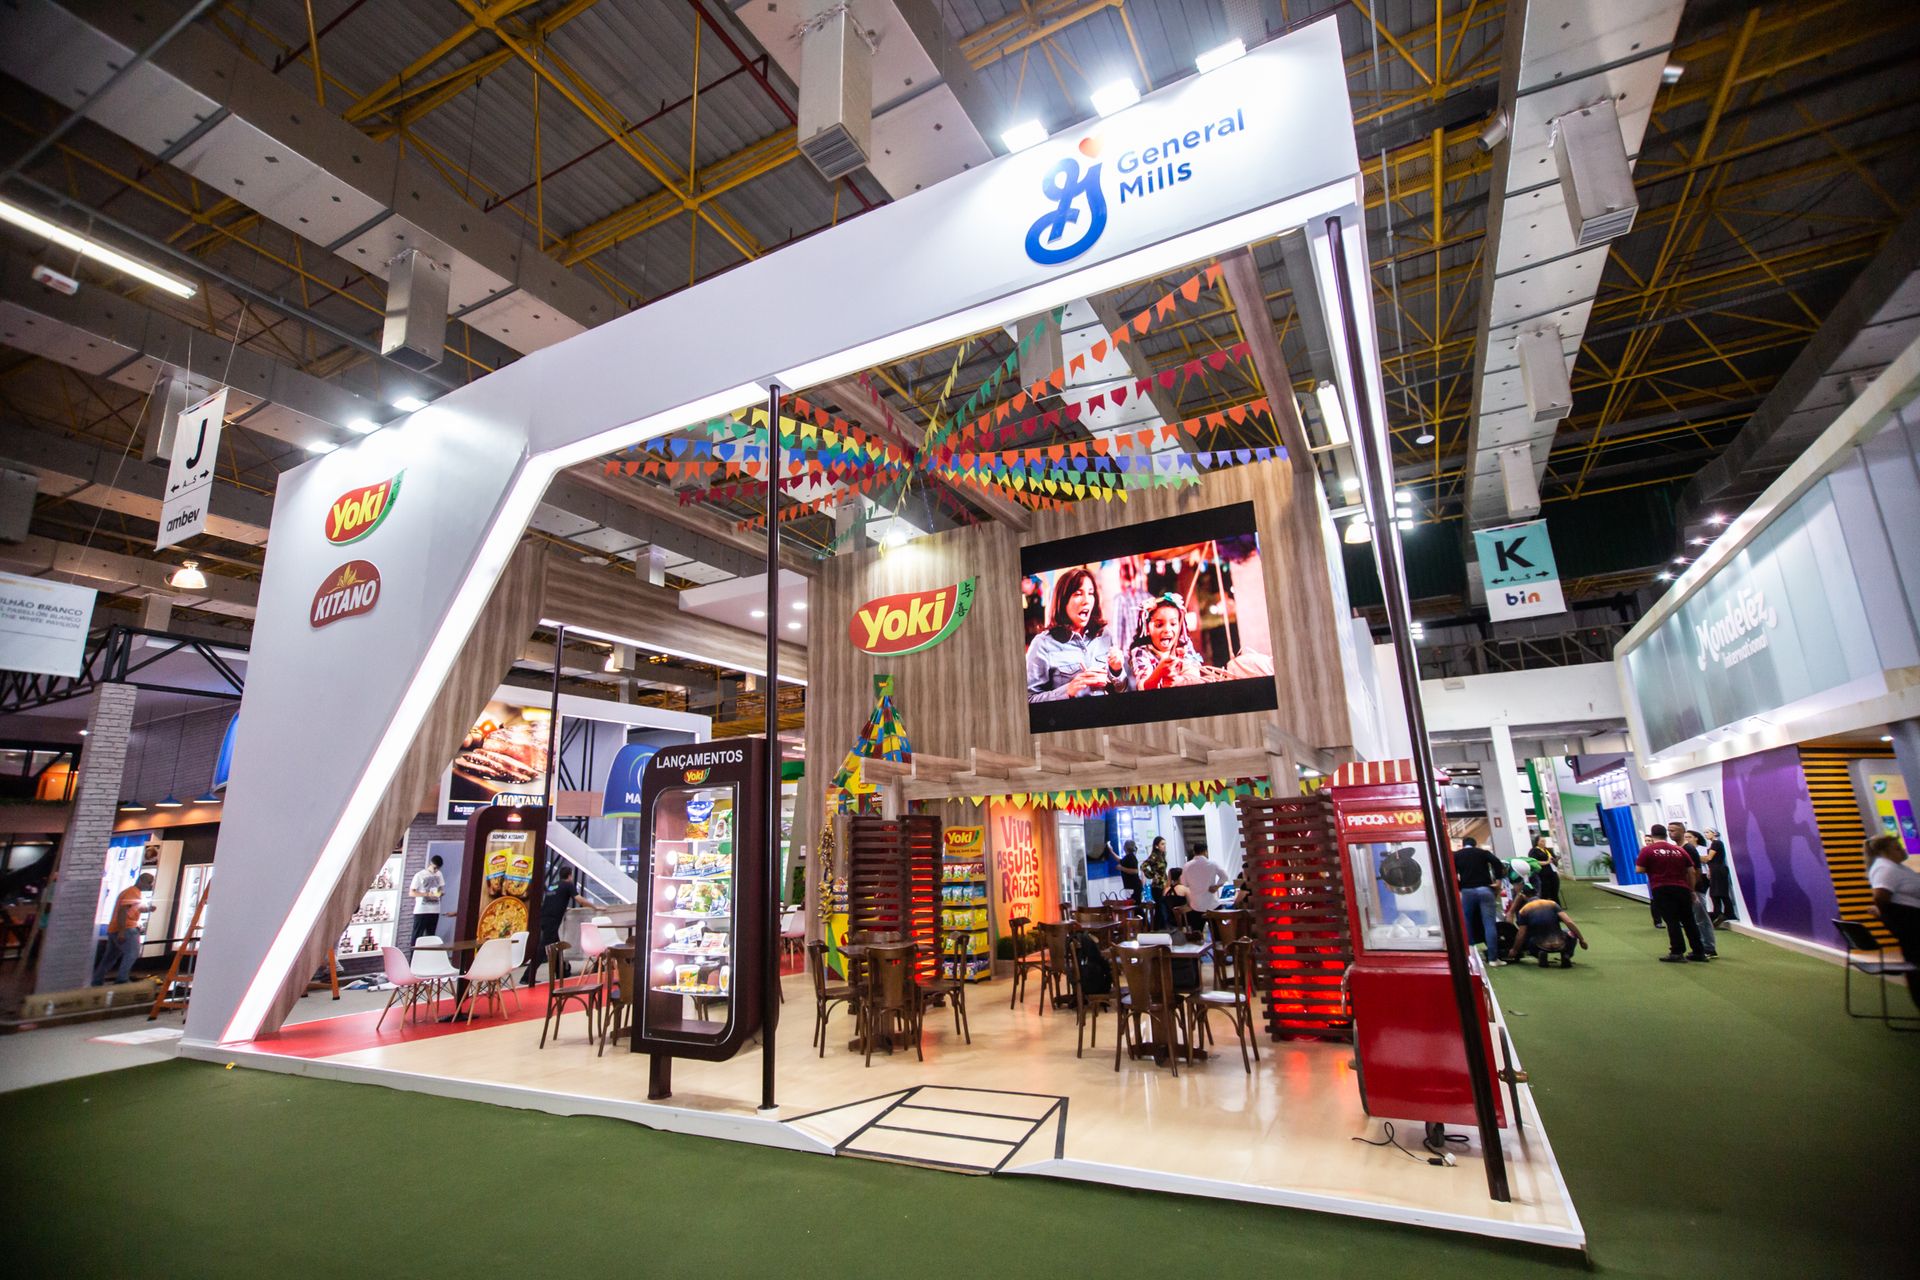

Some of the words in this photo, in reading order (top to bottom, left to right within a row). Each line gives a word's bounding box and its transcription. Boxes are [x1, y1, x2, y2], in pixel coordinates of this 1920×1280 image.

[1117, 108, 1245, 174] General
[1120, 162, 1193, 204] Mills
[186, 418, 209, 469] J
[166, 508, 200, 532] ambev
[332, 483, 387, 539] Yoki
[1494, 536, 1535, 572] K
[37, 603, 83, 616] BRANCO
[314, 581, 377, 622] KITANO
[1505, 590, 1541, 606] bin
[858, 592, 947, 649] Yoki
[656, 749, 744, 769] LANÇAMENTOS
[686, 770, 705, 781] Yoki
[1347, 814, 1388, 826] PIPOCA
[947, 831, 973, 844] Yoki
